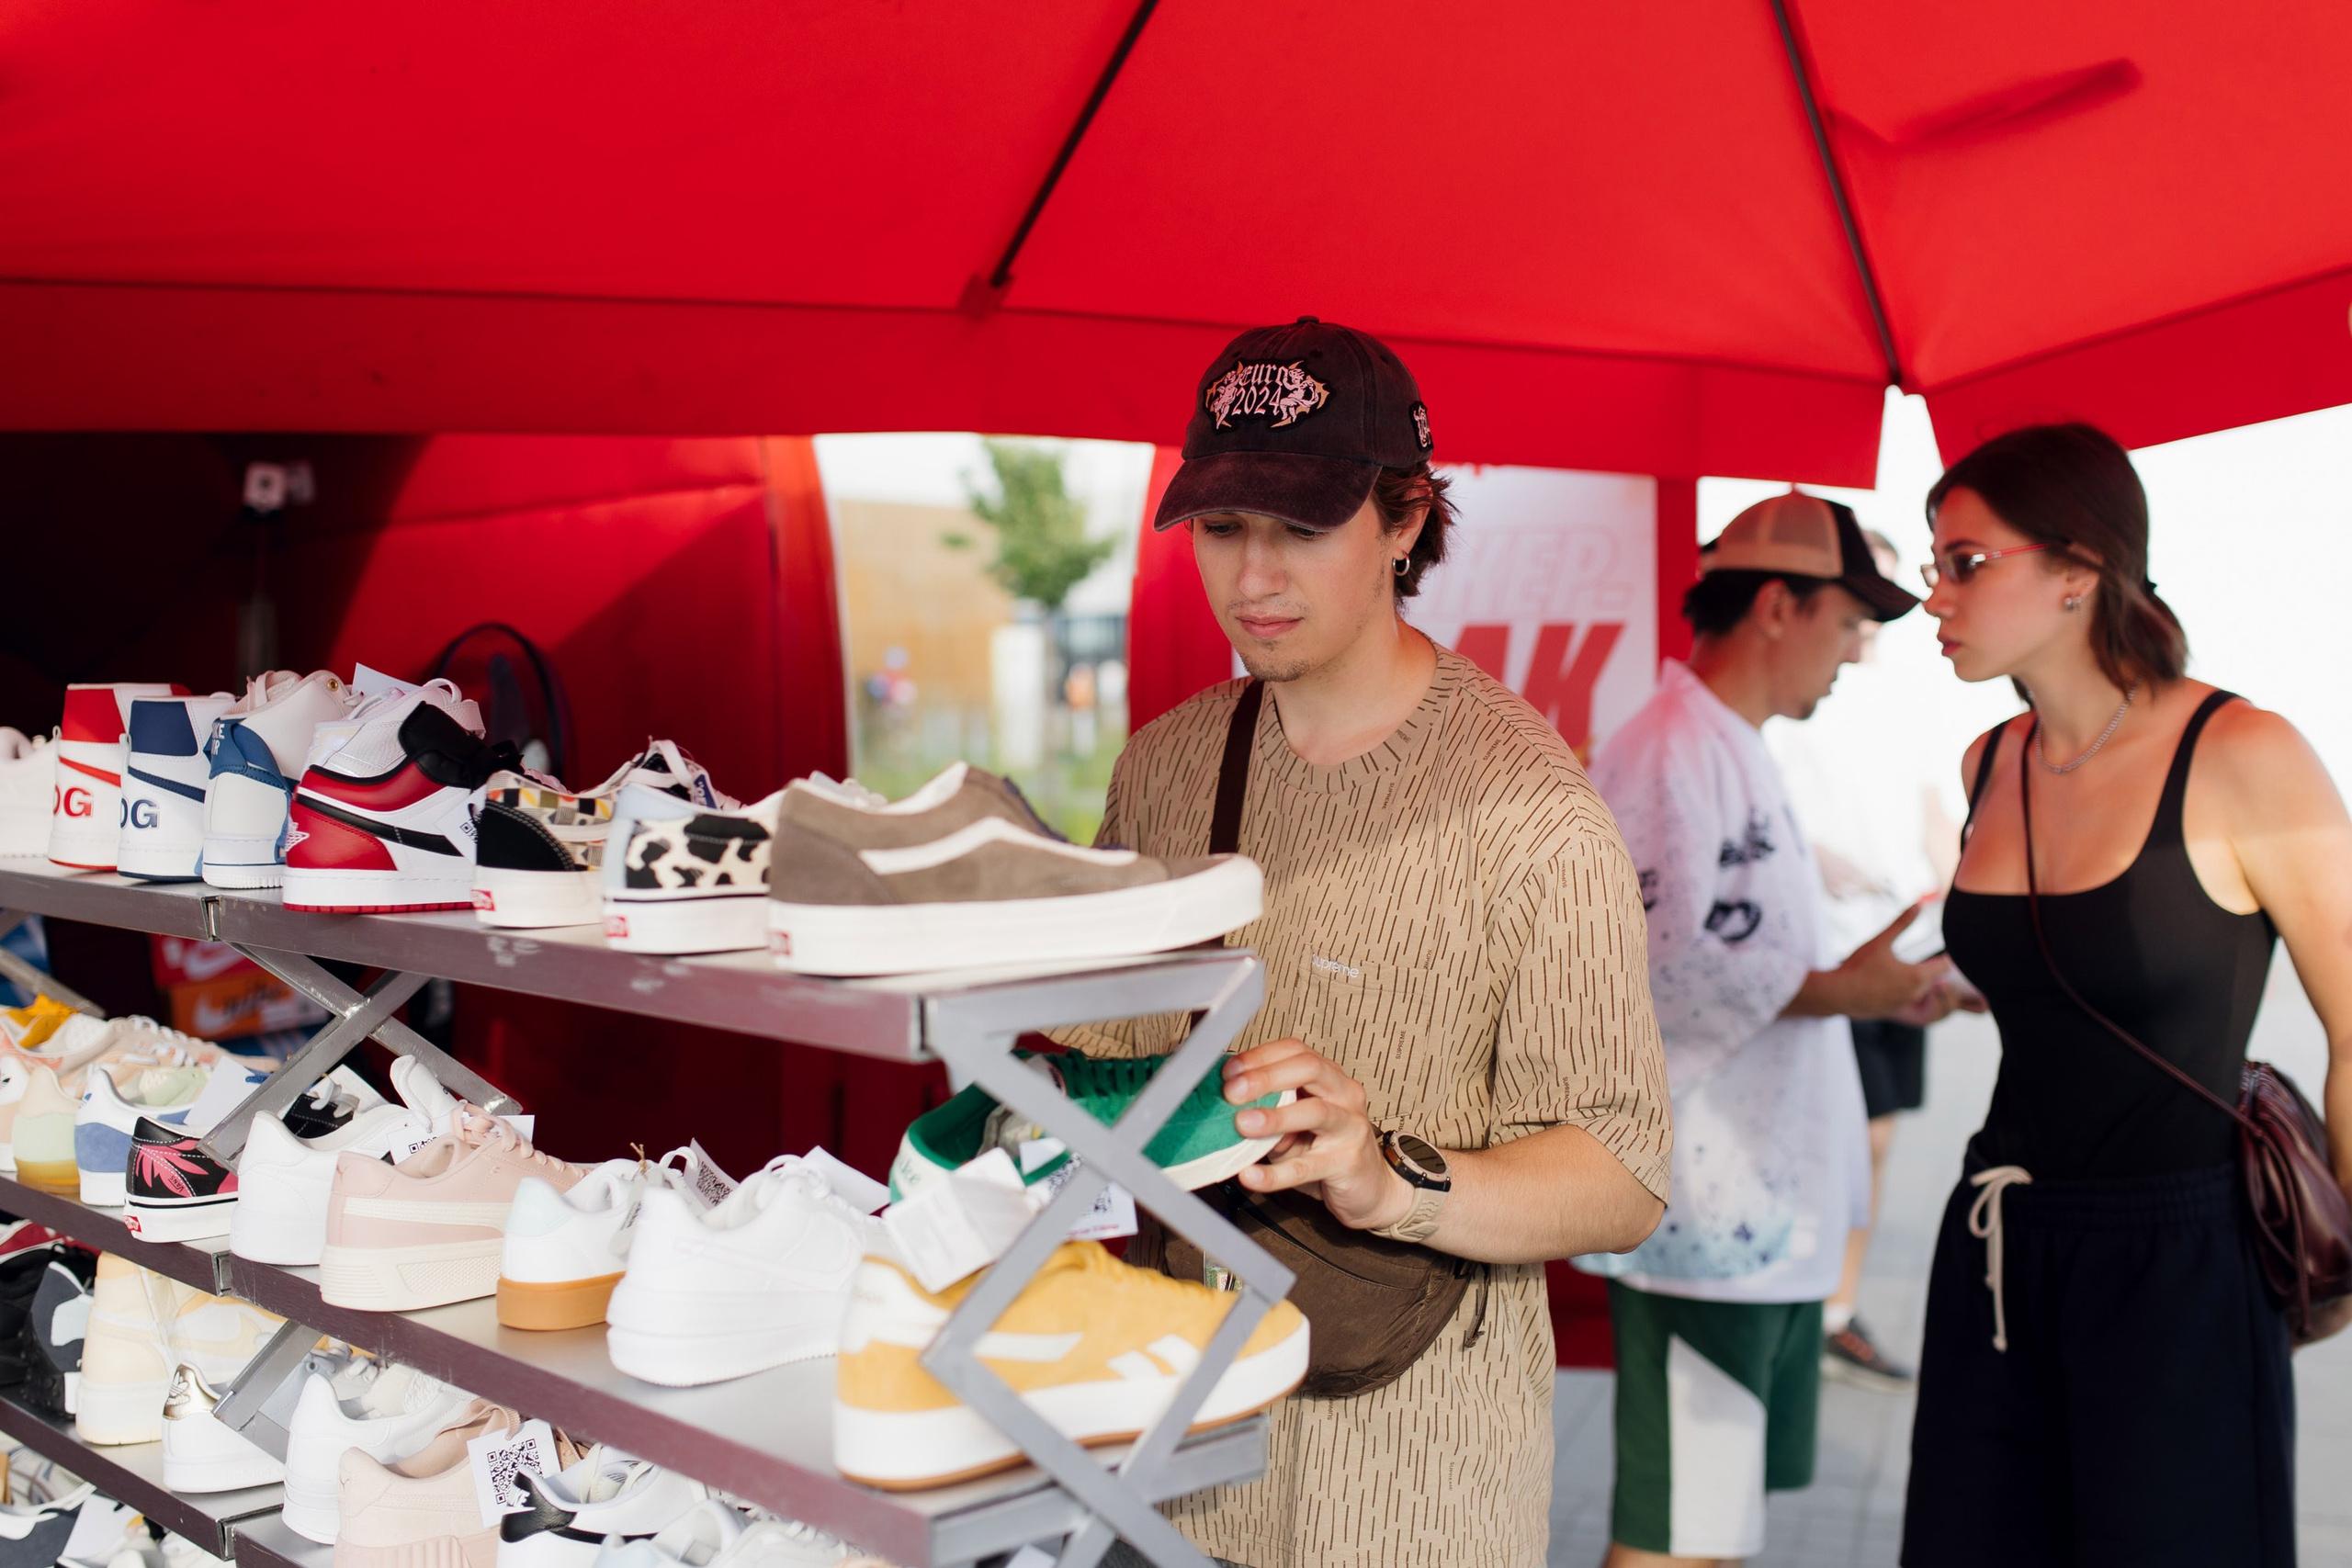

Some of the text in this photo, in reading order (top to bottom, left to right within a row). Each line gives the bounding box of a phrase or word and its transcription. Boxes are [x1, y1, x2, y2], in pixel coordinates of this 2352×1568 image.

[1231, 385, 1282, 416] 2024
[1395, 728, 1412, 744] PREME
[1482, 738, 1502, 761] SUPREME
[1381, 782, 1396, 810] SUPREME
[1395, 1029, 1407, 1060] SUPREME
[1562, 1076, 1570, 1100] SUPREM
[168, 1175, 185, 1193] VANS
